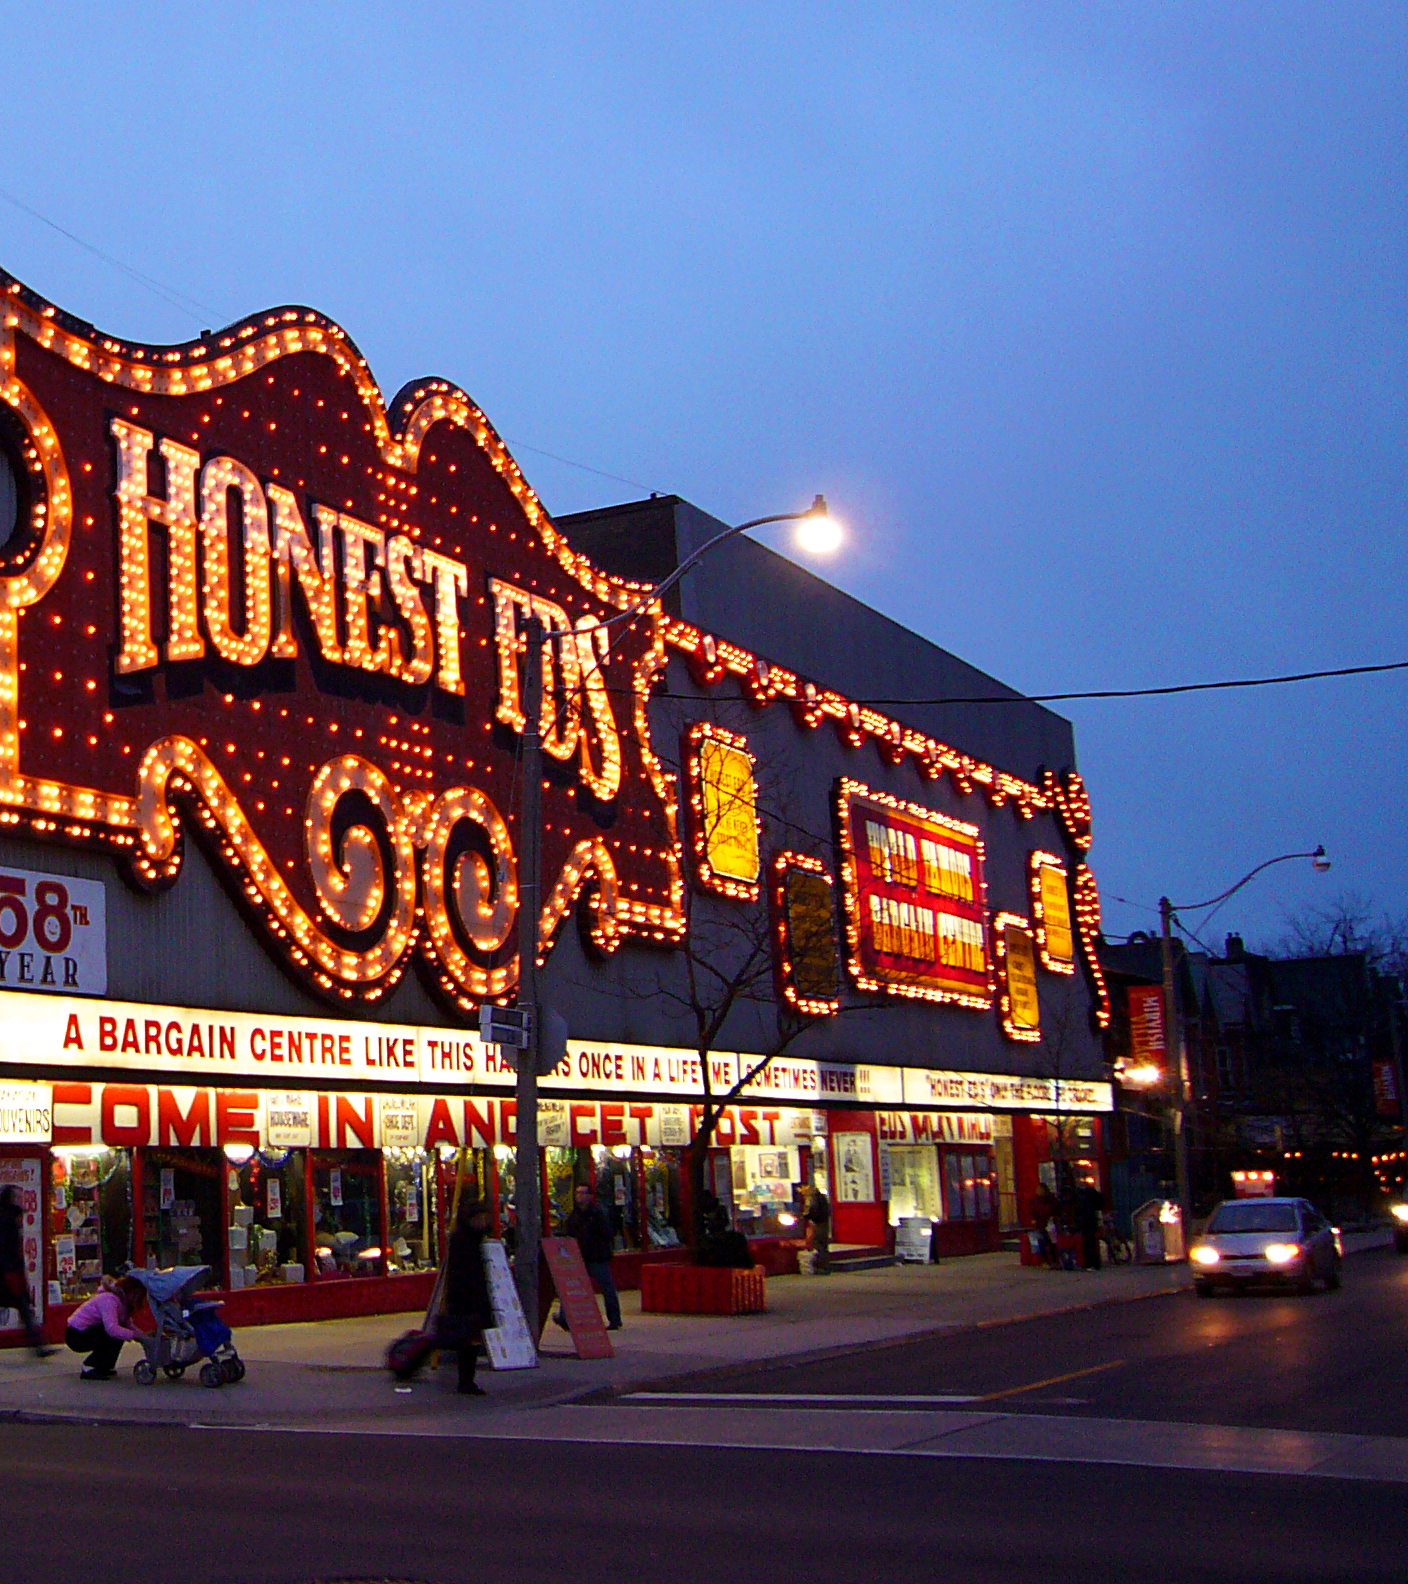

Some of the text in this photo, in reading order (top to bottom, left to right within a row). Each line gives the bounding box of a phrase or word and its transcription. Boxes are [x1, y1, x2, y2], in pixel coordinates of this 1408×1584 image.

[111, 417, 621, 801] HONEST EDS
[63, 1013, 84, 1050] A
[99, 1015, 236, 1059] BARGAIN
[250, 1027, 352, 1065] CENTRE
[365, 1036, 415, 1068] LIKE
[428, 1040, 474, 1071] THIS
[578, 1051, 624, 1080] ONCE
[631, 1056, 645, 1081] IN
[652, 1057, 662, 1082] A
[318, 1094, 374, 1148] IN
[569, 1102, 653, 1147] GET
